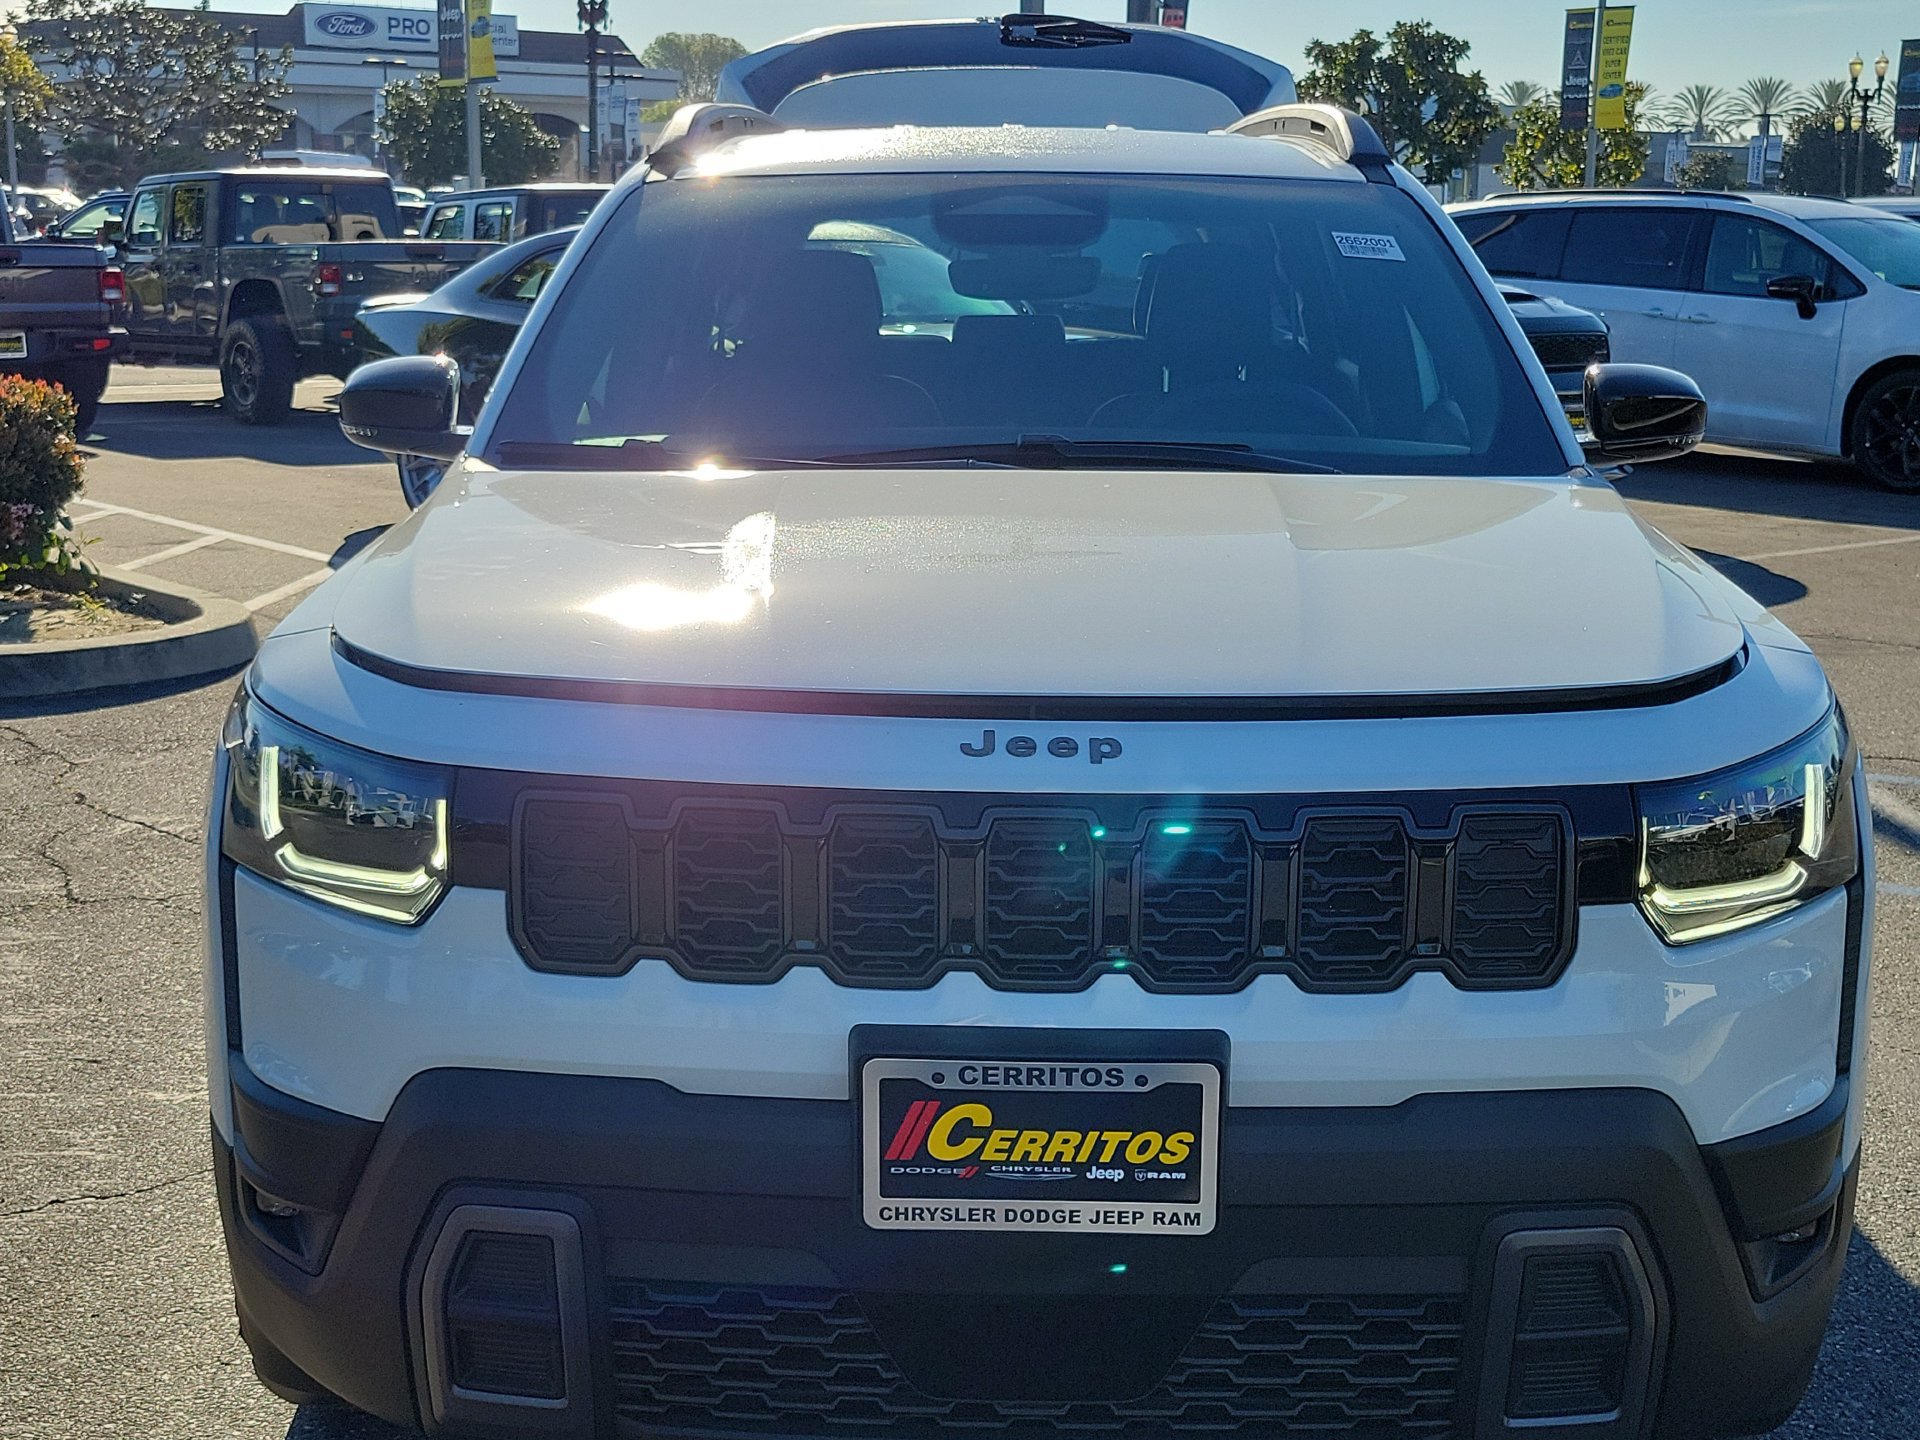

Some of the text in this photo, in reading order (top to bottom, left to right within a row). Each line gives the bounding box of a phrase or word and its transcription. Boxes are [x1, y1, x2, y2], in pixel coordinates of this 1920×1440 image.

[328, 15, 431, 36] Ford PRO
[1565, 76, 1588, 88] Jeep
[1335, 235, 1396, 248] 2662001
[959, 729, 1123, 765] Jeep
[958, 1066, 1125, 1087] CERRITOS
[927, 1103, 1196, 1165] CERRITOS
[890, 1165, 1187, 1182] DODGE CHRYSLER Jeep RAM
[878, 1206, 1202, 1227] CHRYSLER DODGE JEEP RAM
